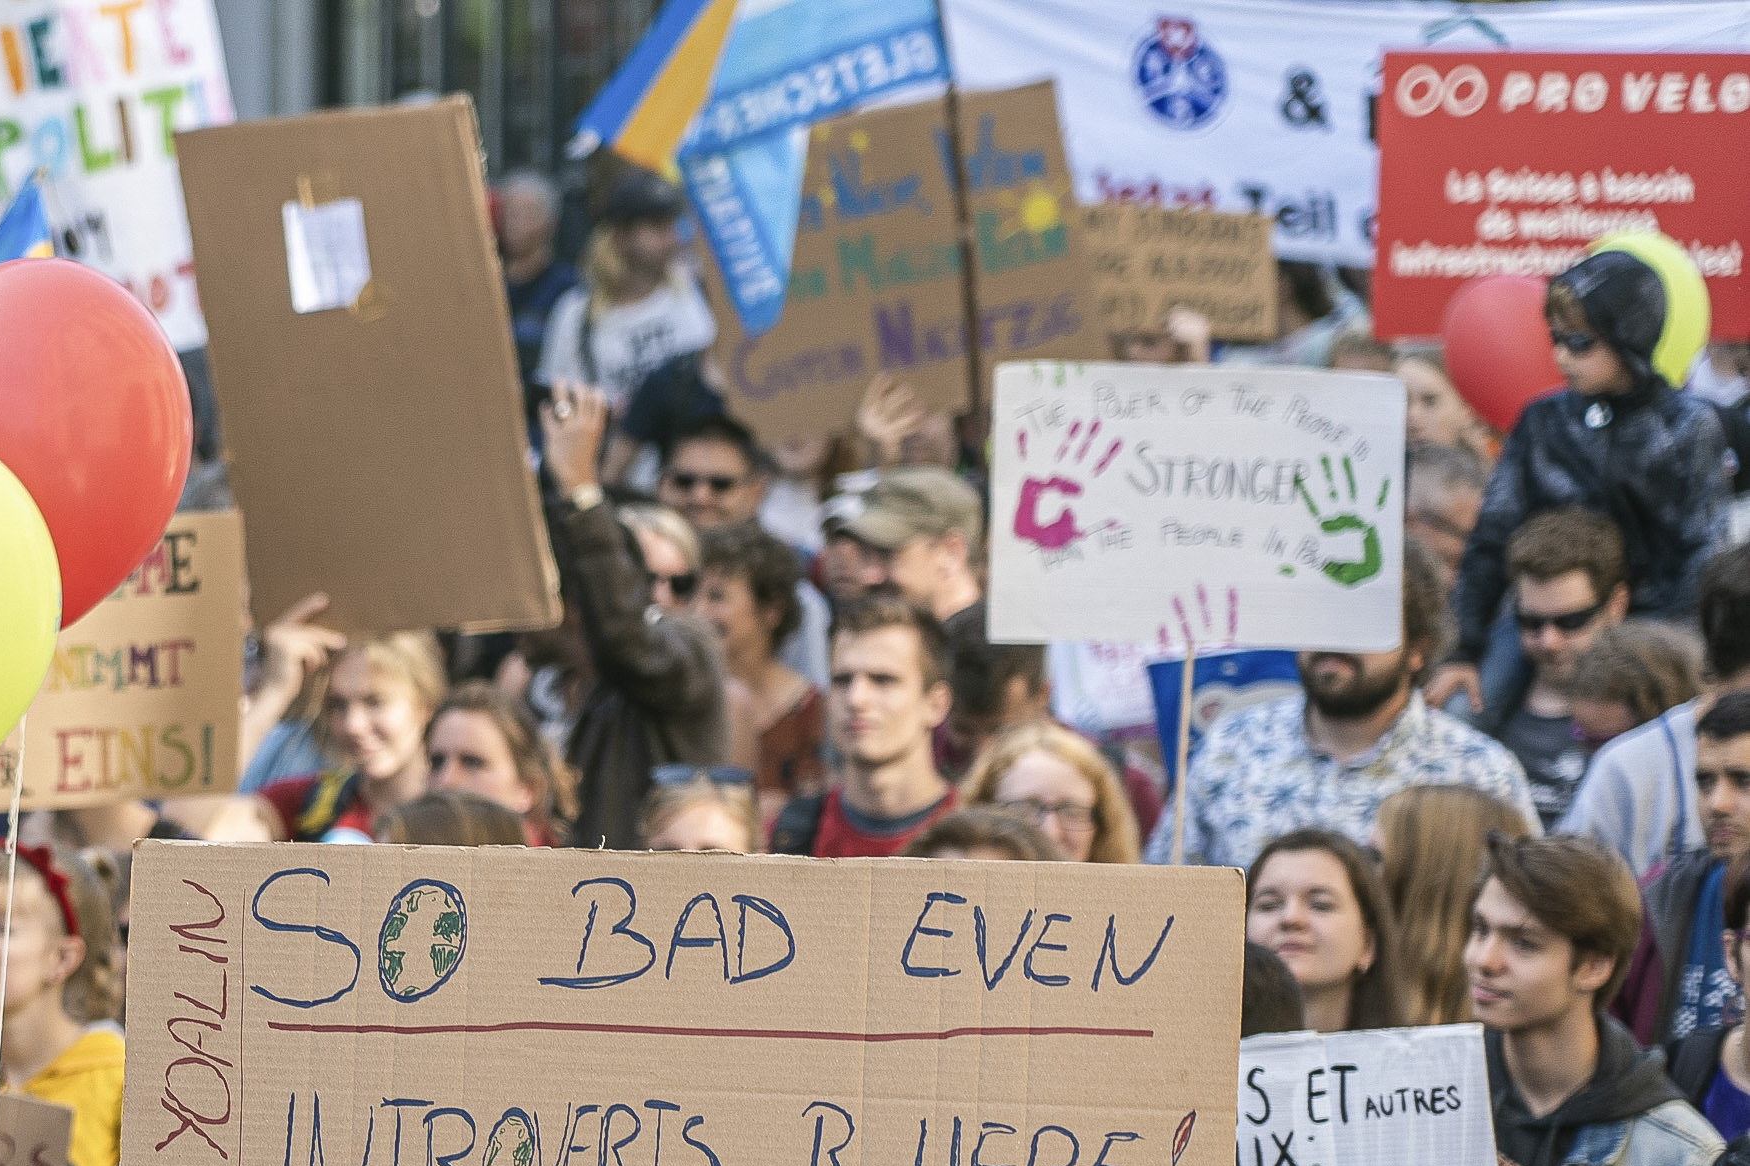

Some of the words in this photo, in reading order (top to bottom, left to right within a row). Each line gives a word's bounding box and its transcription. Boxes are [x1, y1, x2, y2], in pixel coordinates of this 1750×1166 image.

[1281, 72, 1332, 130] &
[1500, 70, 1609, 114] PRO
[1620, 70, 1750, 114] VELO
[1600, 165, 1696, 204] besoin
[1124, 439, 1312, 506] STRONGER
[54, 724, 214, 794] EINS!
[250, 867, 467, 1008] SO
[537, 875, 797, 989] BAD
[900, 891, 1176, 993] EVEN
[1306, 1063, 1360, 1125] ET
[1363, 1084, 1463, 1121] AUTRES
